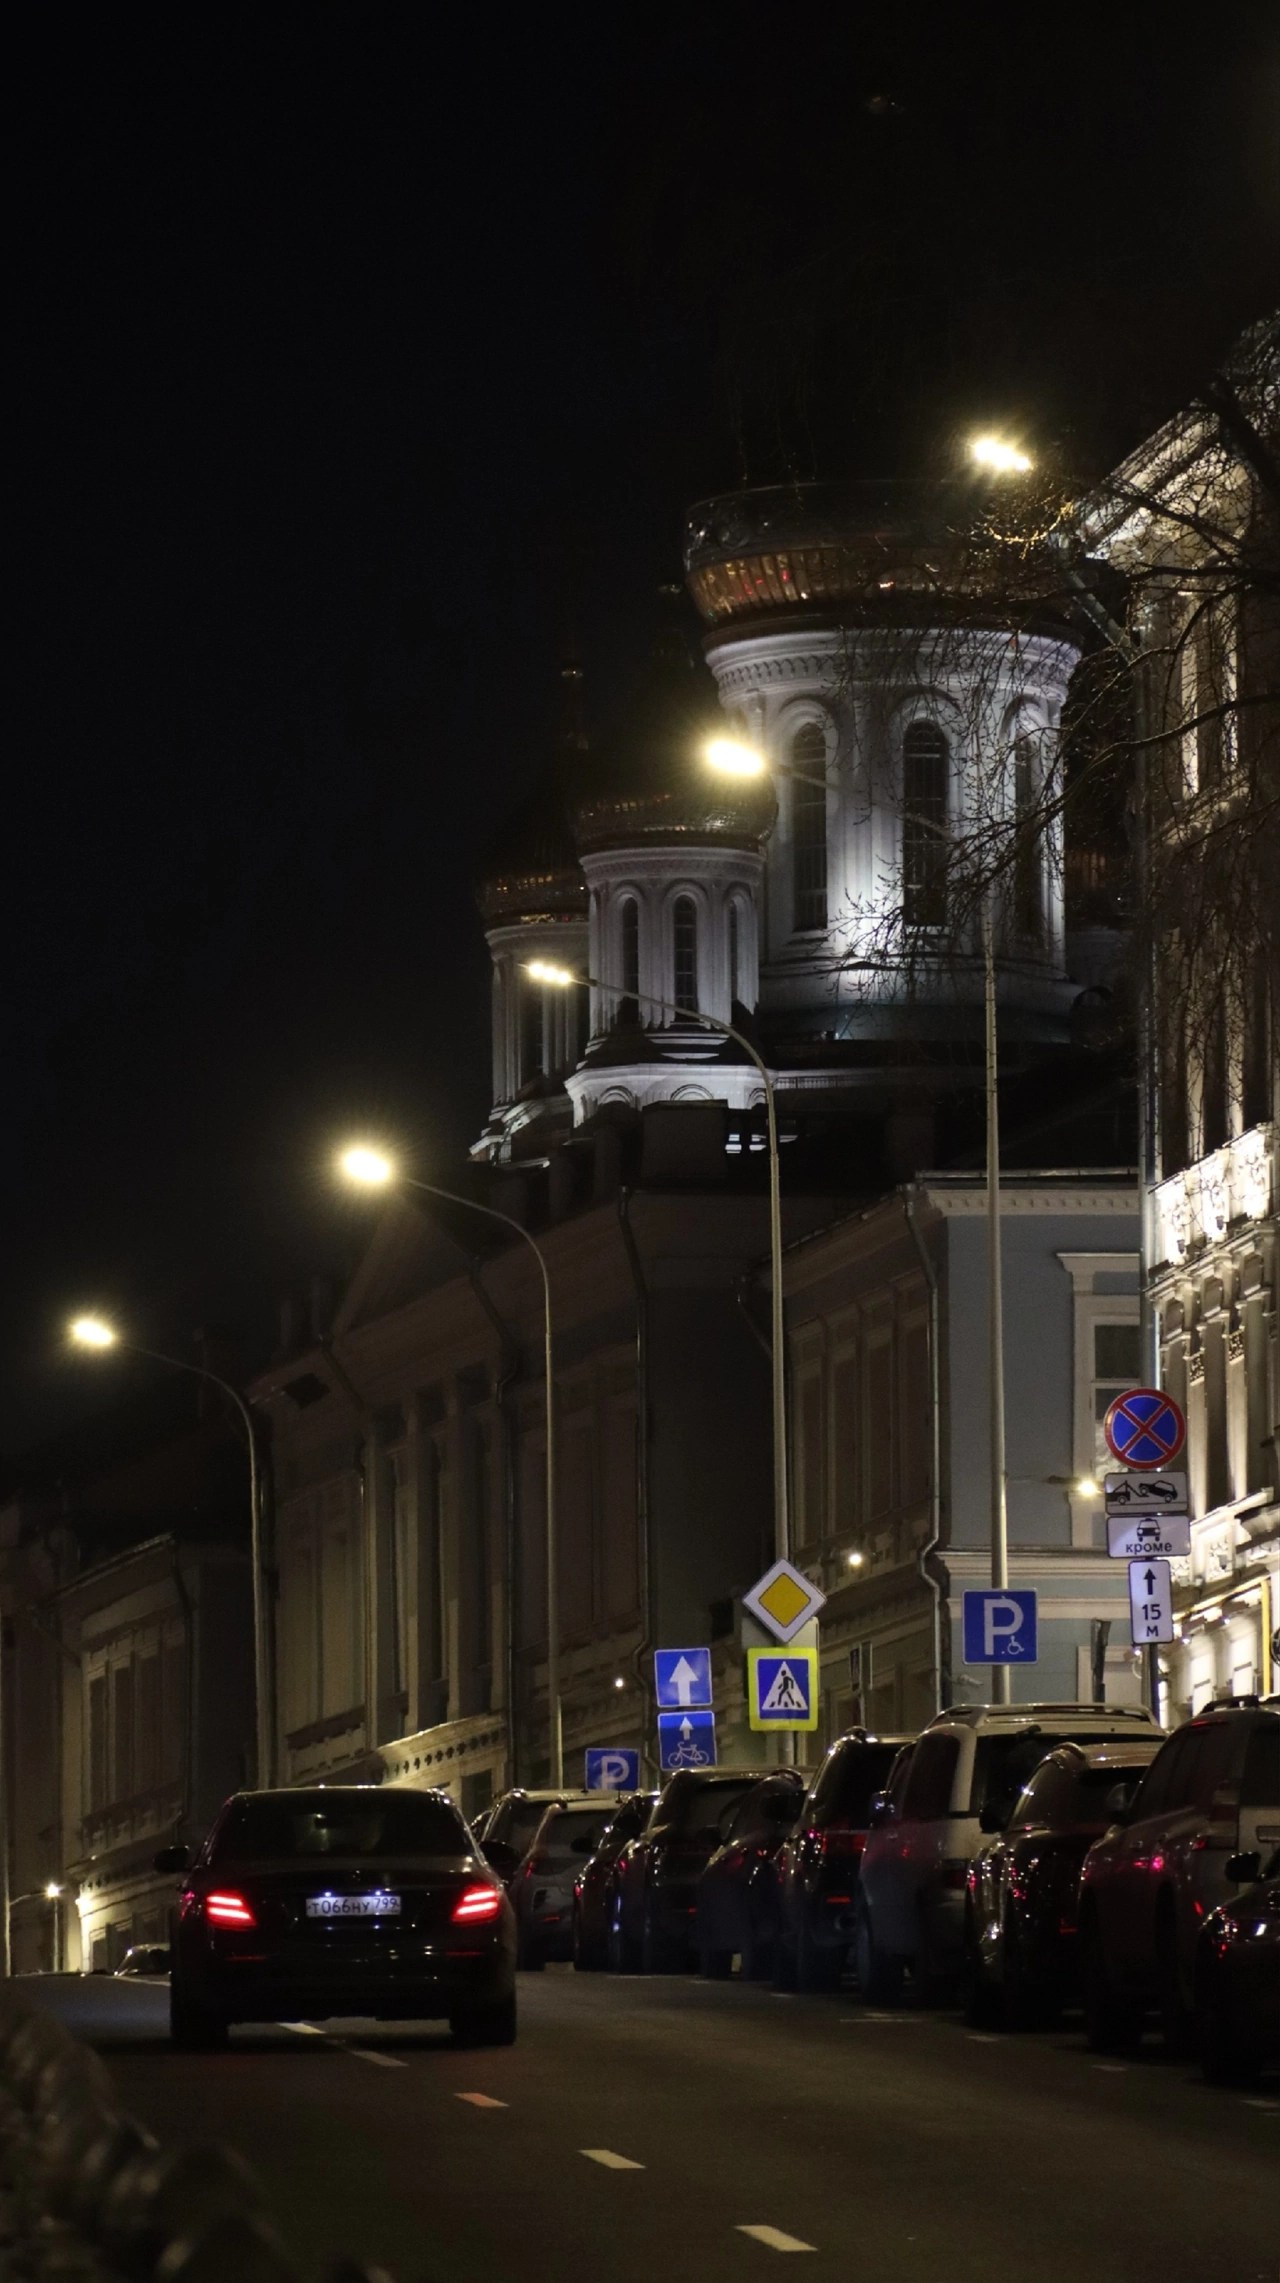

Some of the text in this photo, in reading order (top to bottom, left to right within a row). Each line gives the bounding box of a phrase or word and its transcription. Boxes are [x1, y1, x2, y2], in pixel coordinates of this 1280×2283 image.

[1125, 1542, 1172, 1555] кроме
[1141, 1604, 1161, 1620] 15
[983, 1599, 1024, 1655] P
[601, 1755, 629, 1790] P
